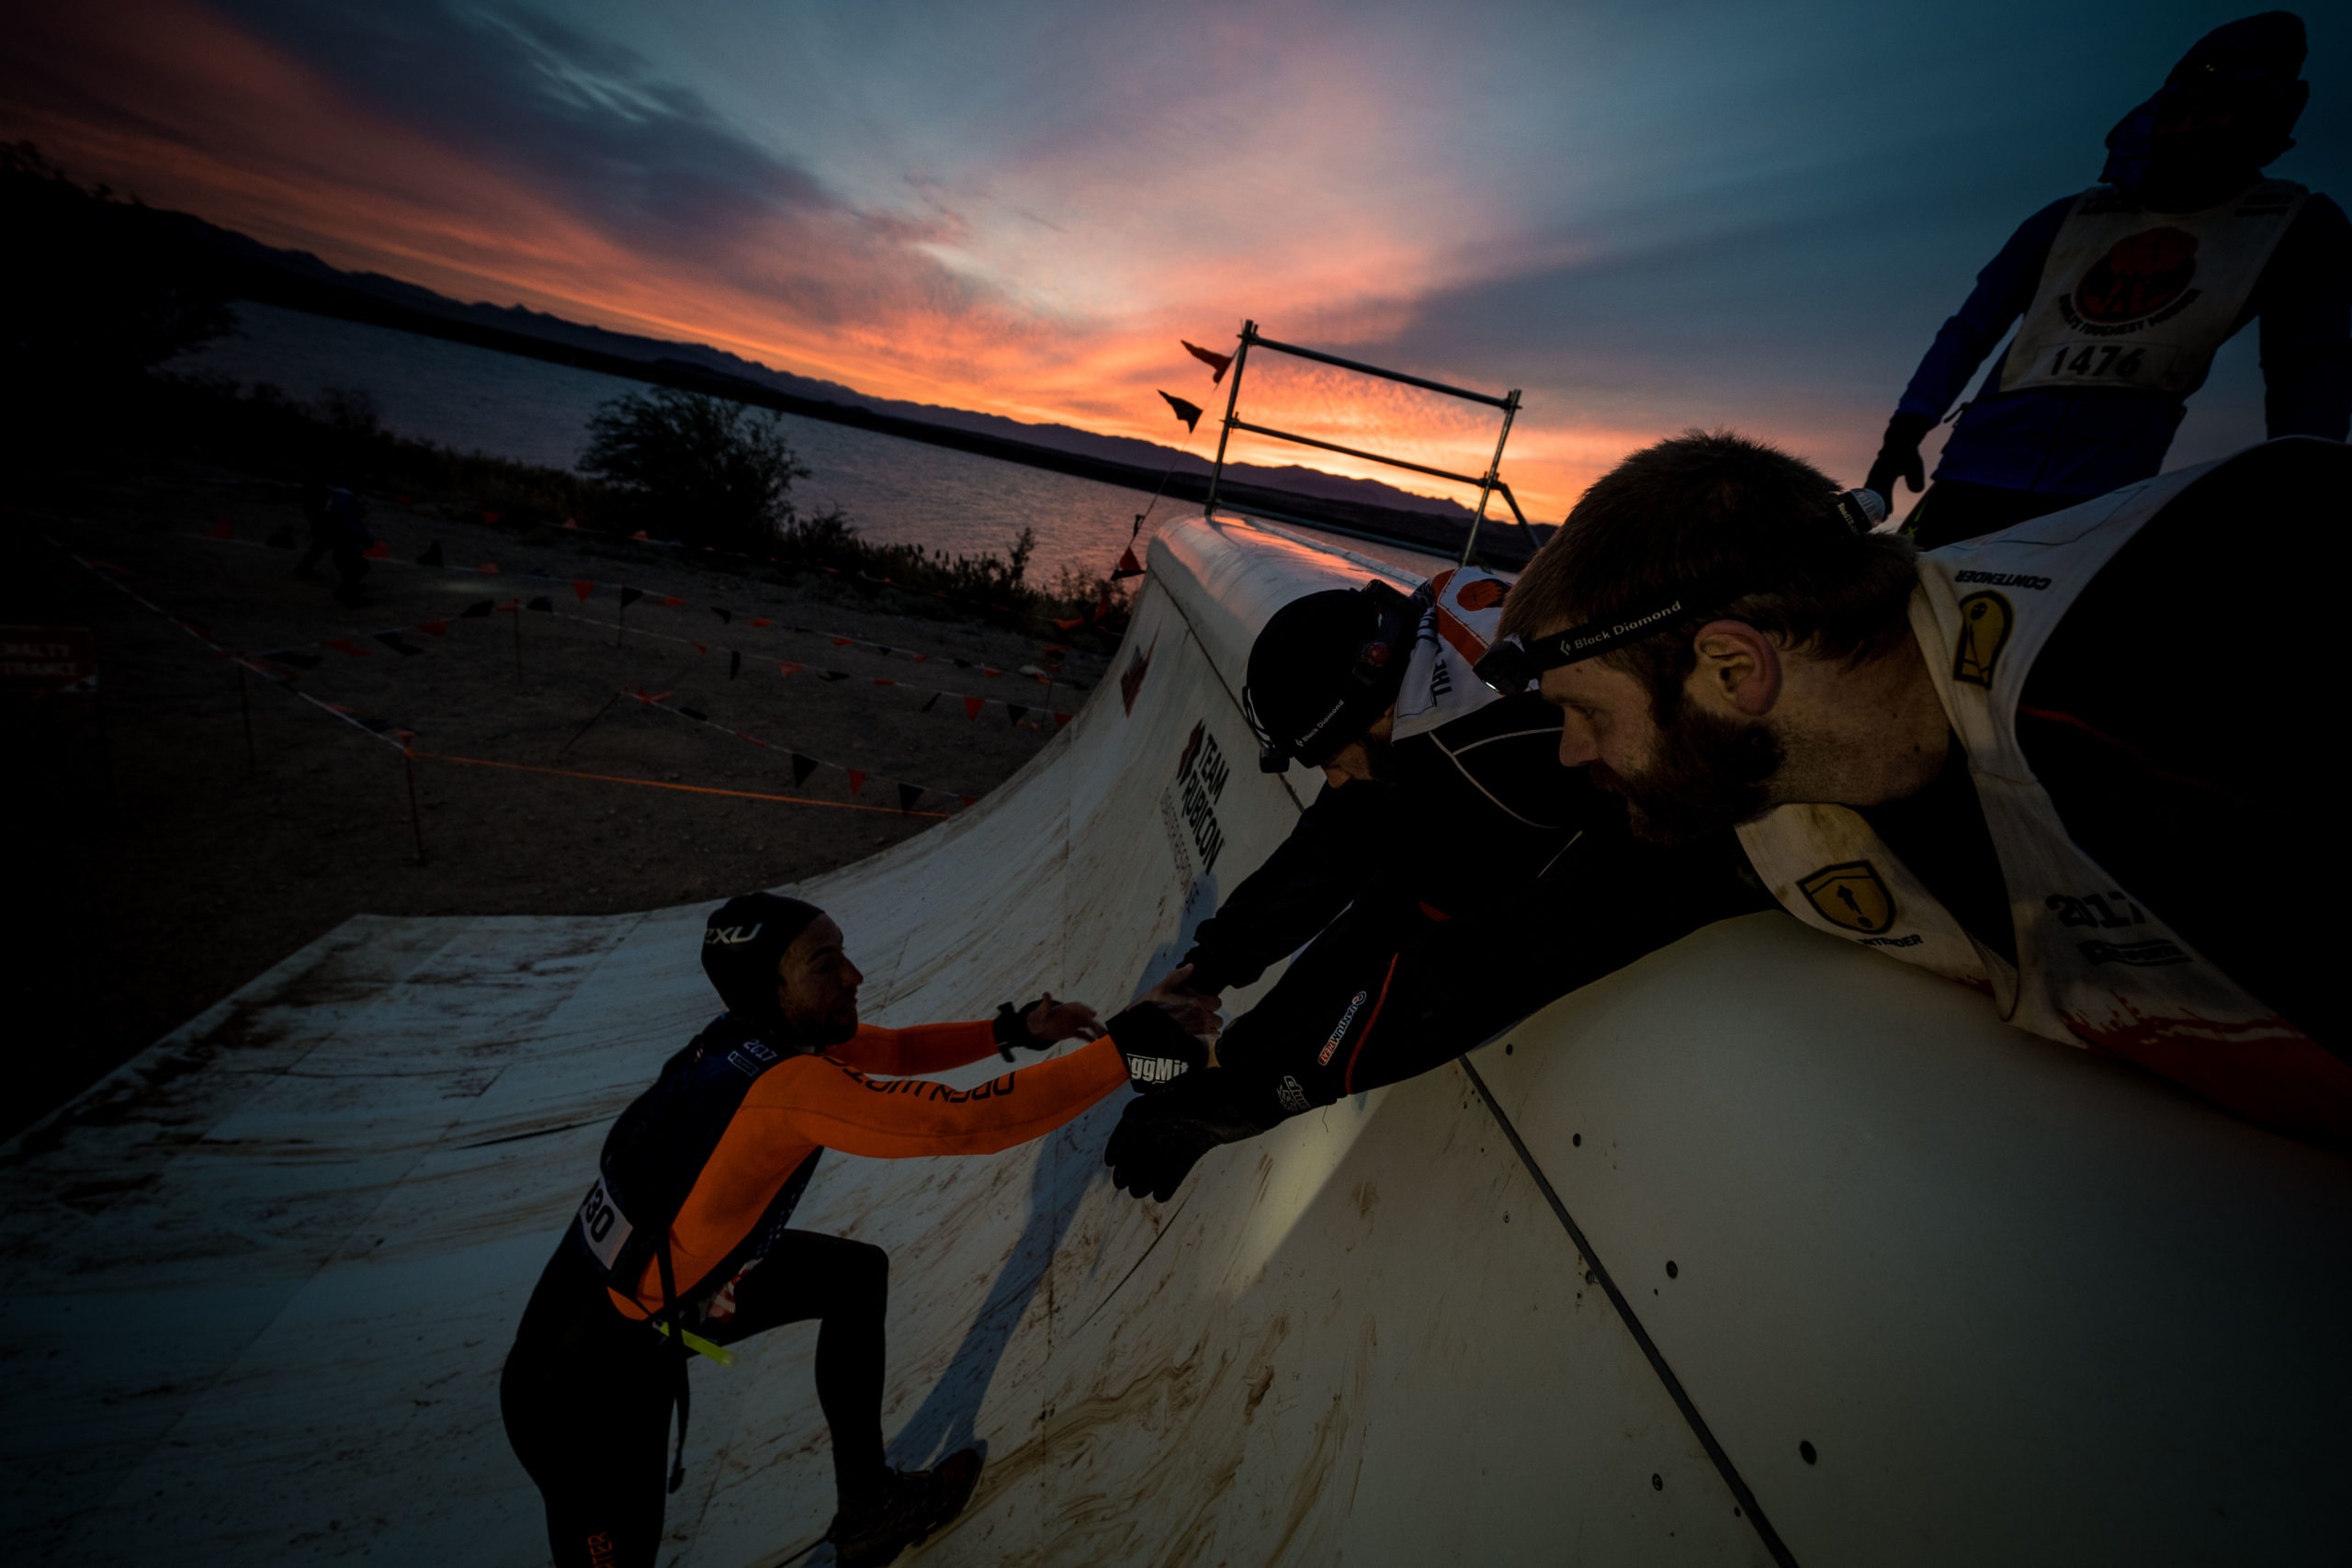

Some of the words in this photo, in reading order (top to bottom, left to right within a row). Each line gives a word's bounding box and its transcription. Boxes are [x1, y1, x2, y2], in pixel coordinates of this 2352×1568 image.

[2051, 346, 2146, 378] 1476
[1954, 570, 2052, 591] CONTENDER
[1574, 630, 1611, 650] Black
[1612, 600, 1682, 637] Diamond
[1316, 698, 1345, 728] Diamond
[1198, 733, 1229, 806] TEAM
[1182, 770, 1225, 876] RUBICON
[742, 1038, 779, 1063] 2017
[582, 1180, 615, 1243] 30
